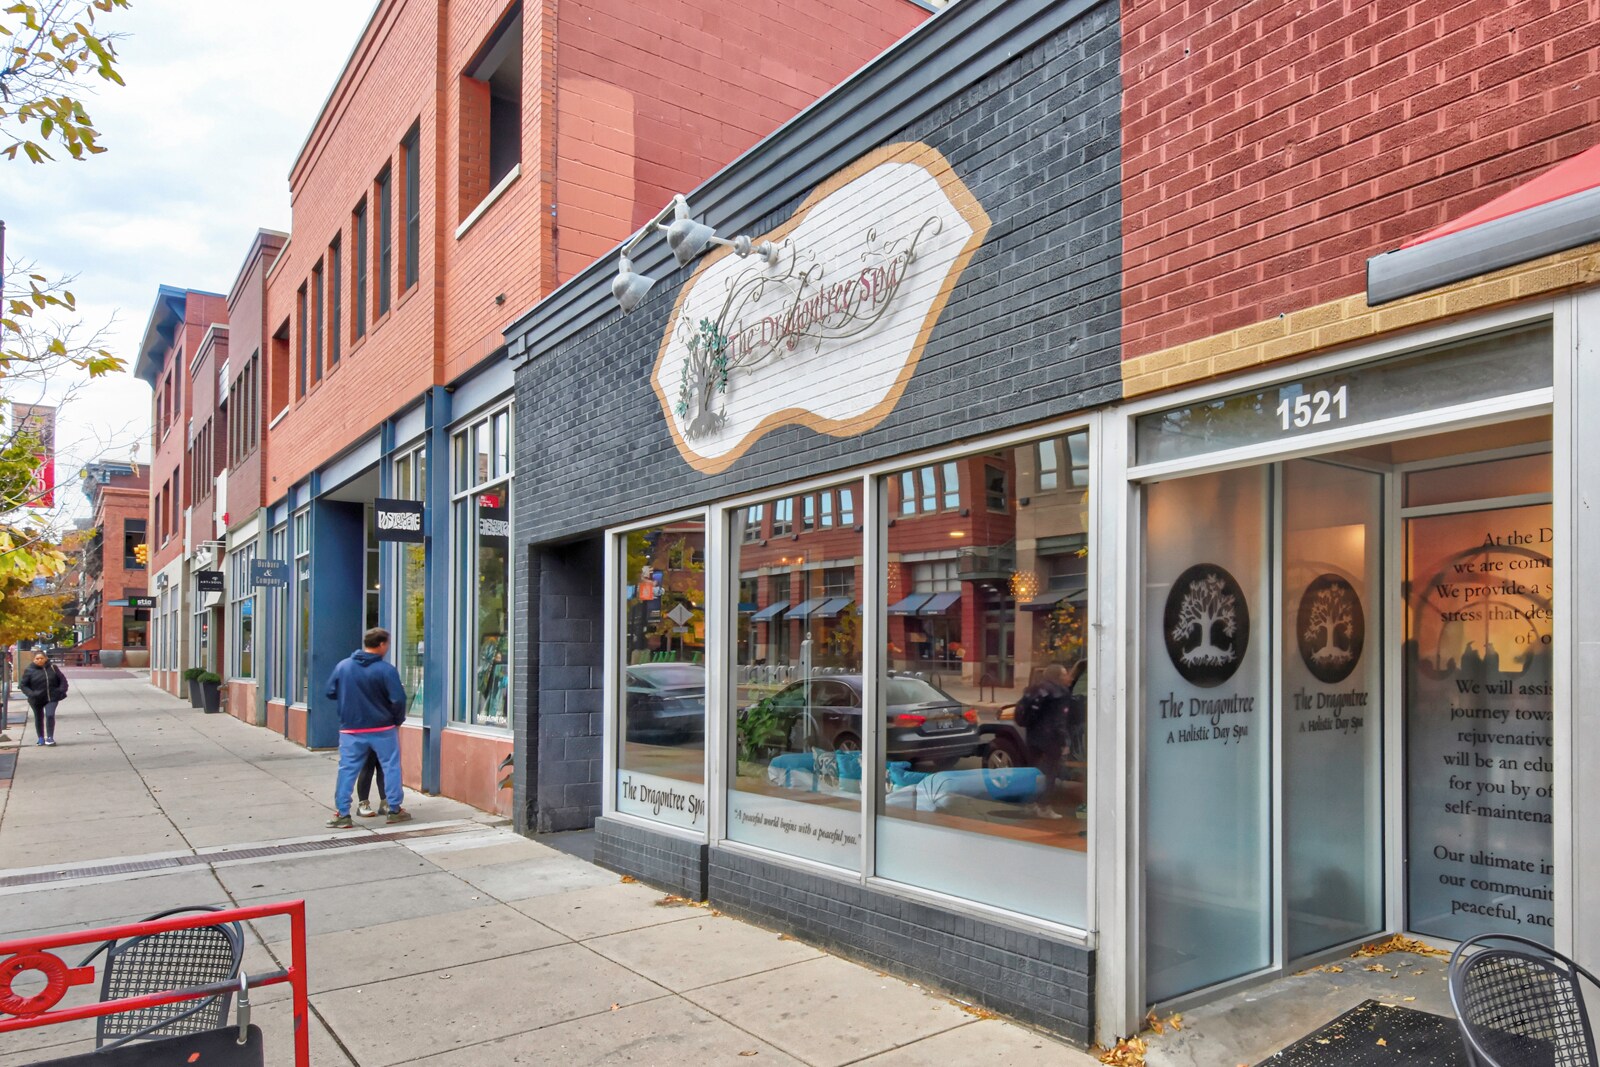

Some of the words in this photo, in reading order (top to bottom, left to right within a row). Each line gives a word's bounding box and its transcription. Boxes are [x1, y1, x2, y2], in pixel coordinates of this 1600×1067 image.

[729, 319, 754, 361] The
[760, 280, 856, 352] Dragontree
[858, 257, 898, 311] Spa
[1276, 385, 1347, 431] 1521
[1483, 532, 1502, 547] At
[1507, 530, 1533, 545] the
[1453, 562, 1475, 574] we
[1480, 559, 1504, 572] are
[1436, 583, 1460, 598] We
[1465, 580, 1526, 602] provide
[1531, 584, 1540, 594] a
[1441, 608, 1483, 622] stress
[1489, 605, 1521, 621] that
[1515, 628, 1535, 645] of
[1456, 679, 1480, 694] We
[1485, 680, 1513, 695] will
[1159, 692, 1184, 719] The
[1189, 693, 1255, 726] Dragontree
[1293, 687, 1313, 710] The
[1317, 688, 1368, 717] Dragontree
[1450, 703, 1510, 724] journey
[1166, 731, 1175, 744] A
[1178, 723, 1210, 743] Holistic
[1213, 726, 1231, 745] Day
[1232, 724, 1249, 744] Spa
[1299, 721, 1306, 732] A
[1308, 715, 1333, 732] Holistic
[1335, 718, 1349, 735] Day
[1350, 716, 1364, 734] Spa
[1457, 728, 1553, 747] rejuvenative
[1443, 752, 1469, 767] will
[1475, 752, 1494, 768] be
[1499, 759, 1518, 770] an
[1523, 756, 1553, 773] edu
[623, 776, 637, 800] The
[640, 785, 685, 815] Dragontree
[1449, 775, 1472, 790] for
[1476, 781, 1505, 796] you
[1511, 780, 1531, 800] by
[1445, 800, 1553, 824] self-maintena
[742, 812, 763, 826] peaceful
[763, 816, 780, 828] world
[780, 818, 797, 834] begins
[798, 822, 812, 836] with
[812, 828, 817, 836] a
[817, 827, 844, 844] peaceful
[1433, 845, 1465, 862] Our
[1470, 850, 1535, 873] ultimate
[1439, 874, 1466, 887] our
[1451, 900, 1521, 924] peaceful,
